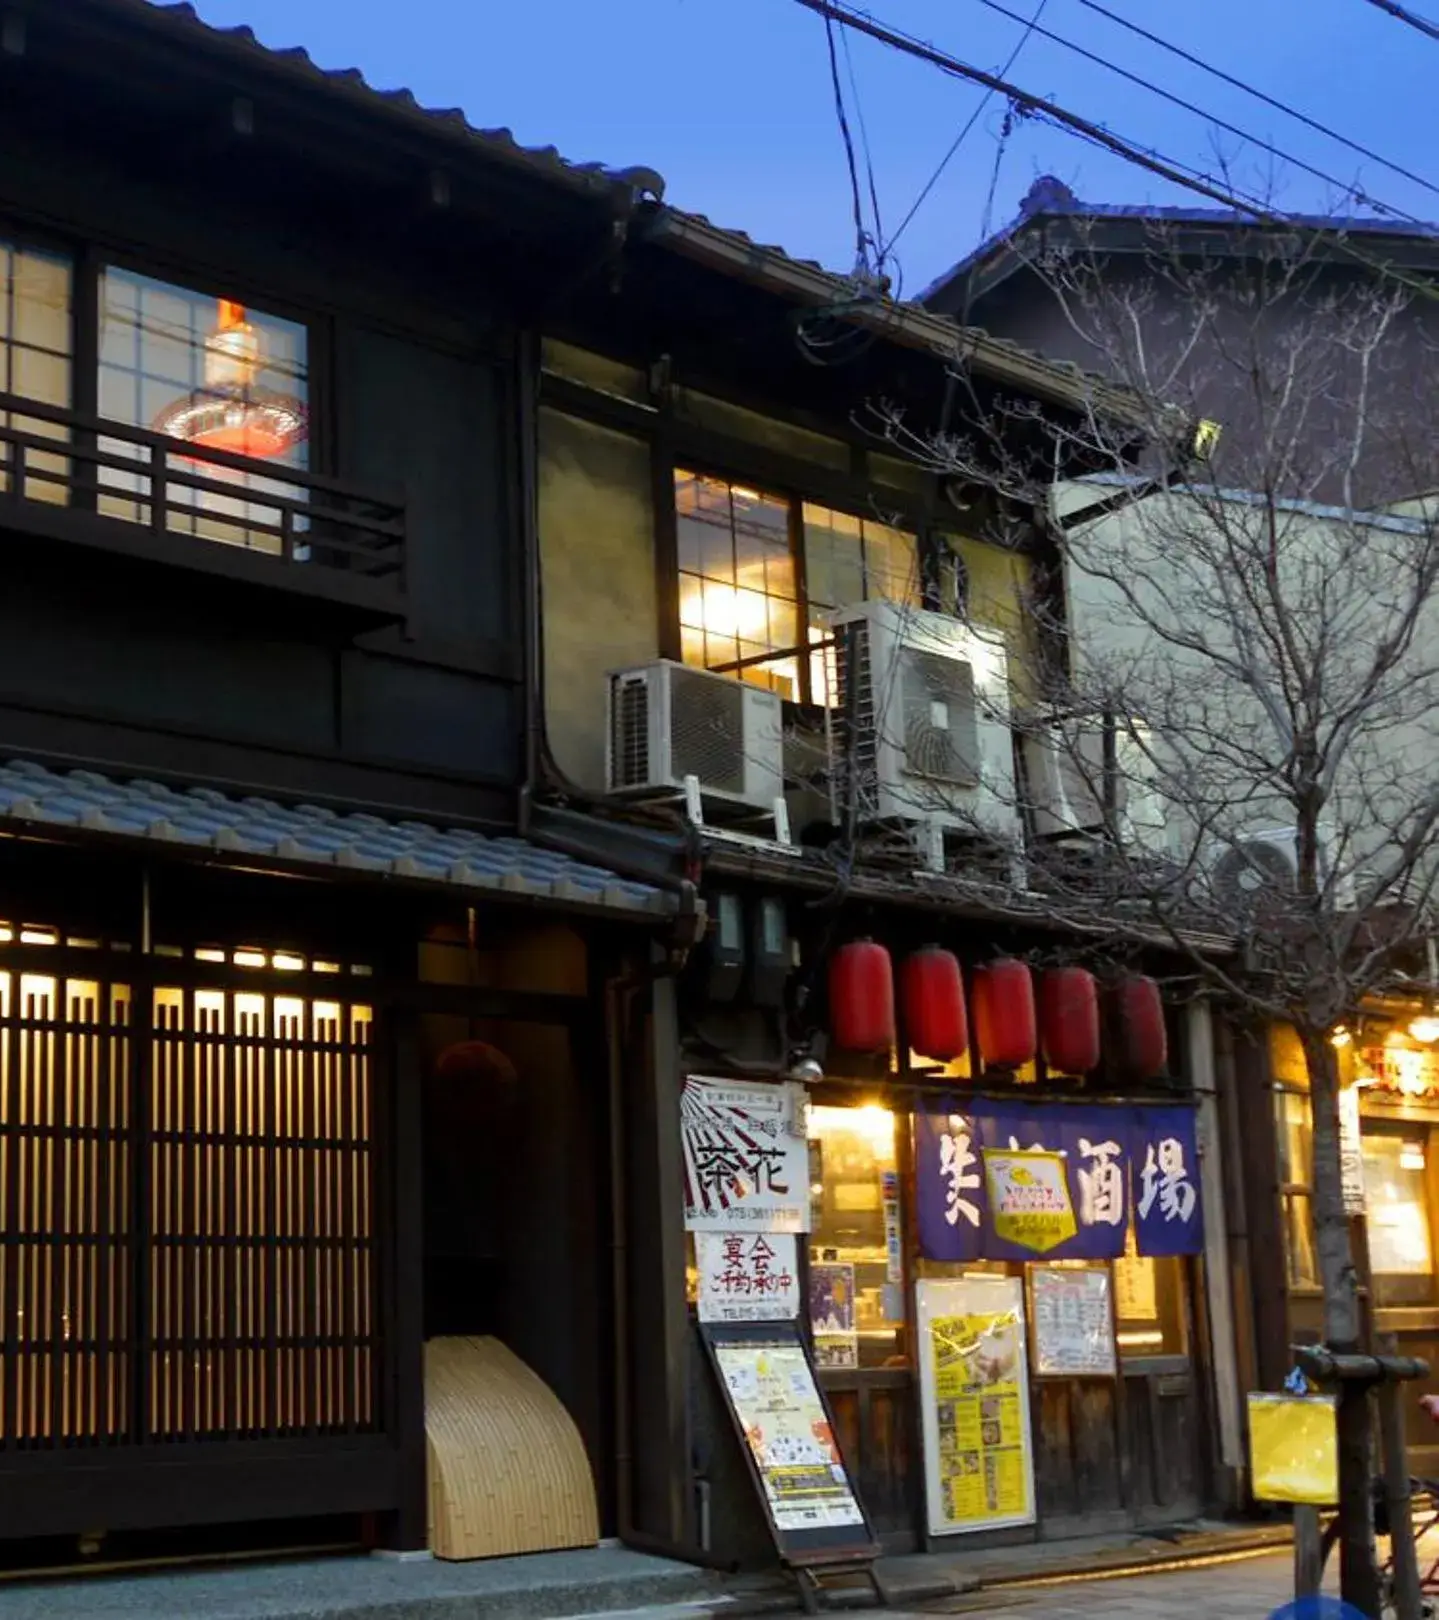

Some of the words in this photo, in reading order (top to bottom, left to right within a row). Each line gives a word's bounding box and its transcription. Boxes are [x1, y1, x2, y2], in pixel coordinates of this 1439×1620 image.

[697, 1144, 789, 1194] 茶花
[940, 1133, 1196, 1227] 笑酒場
[722, 1233, 775, 1269] 宴会
[710, 1267, 792, 1295] ご予約承り中
